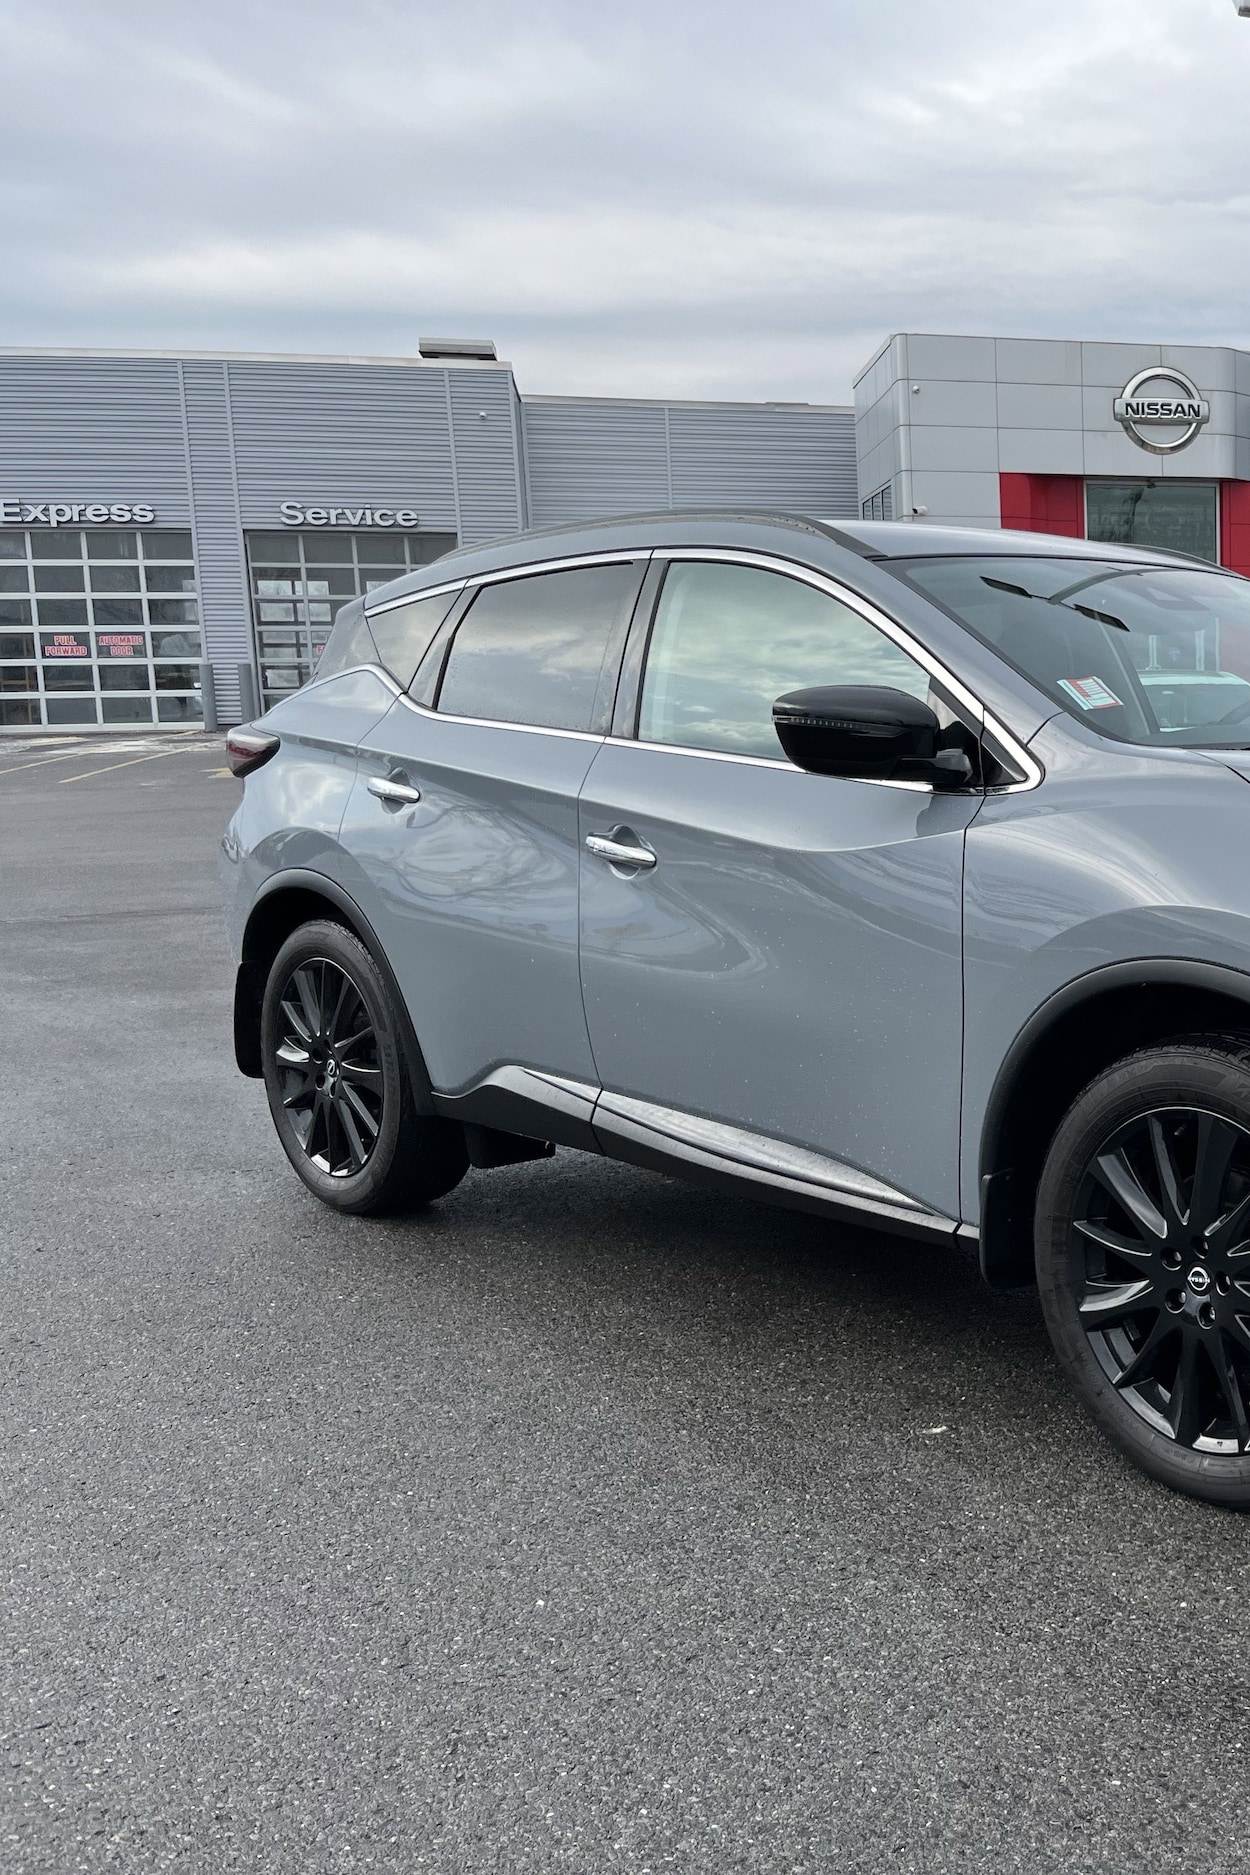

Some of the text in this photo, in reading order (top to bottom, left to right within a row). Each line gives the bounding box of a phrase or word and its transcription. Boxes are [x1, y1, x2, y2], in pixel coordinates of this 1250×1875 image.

[1124, 401, 1201, 419] NISSAN
[0, 498, 155, 527] Express
[280, 501, 418, 527] Service
[54, 635, 77, 645] PULL
[99, 635, 144, 645] AUTOMATIC
[45, 646, 87, 656] FORWARD
[110, 646, 134, 656] DOOR
